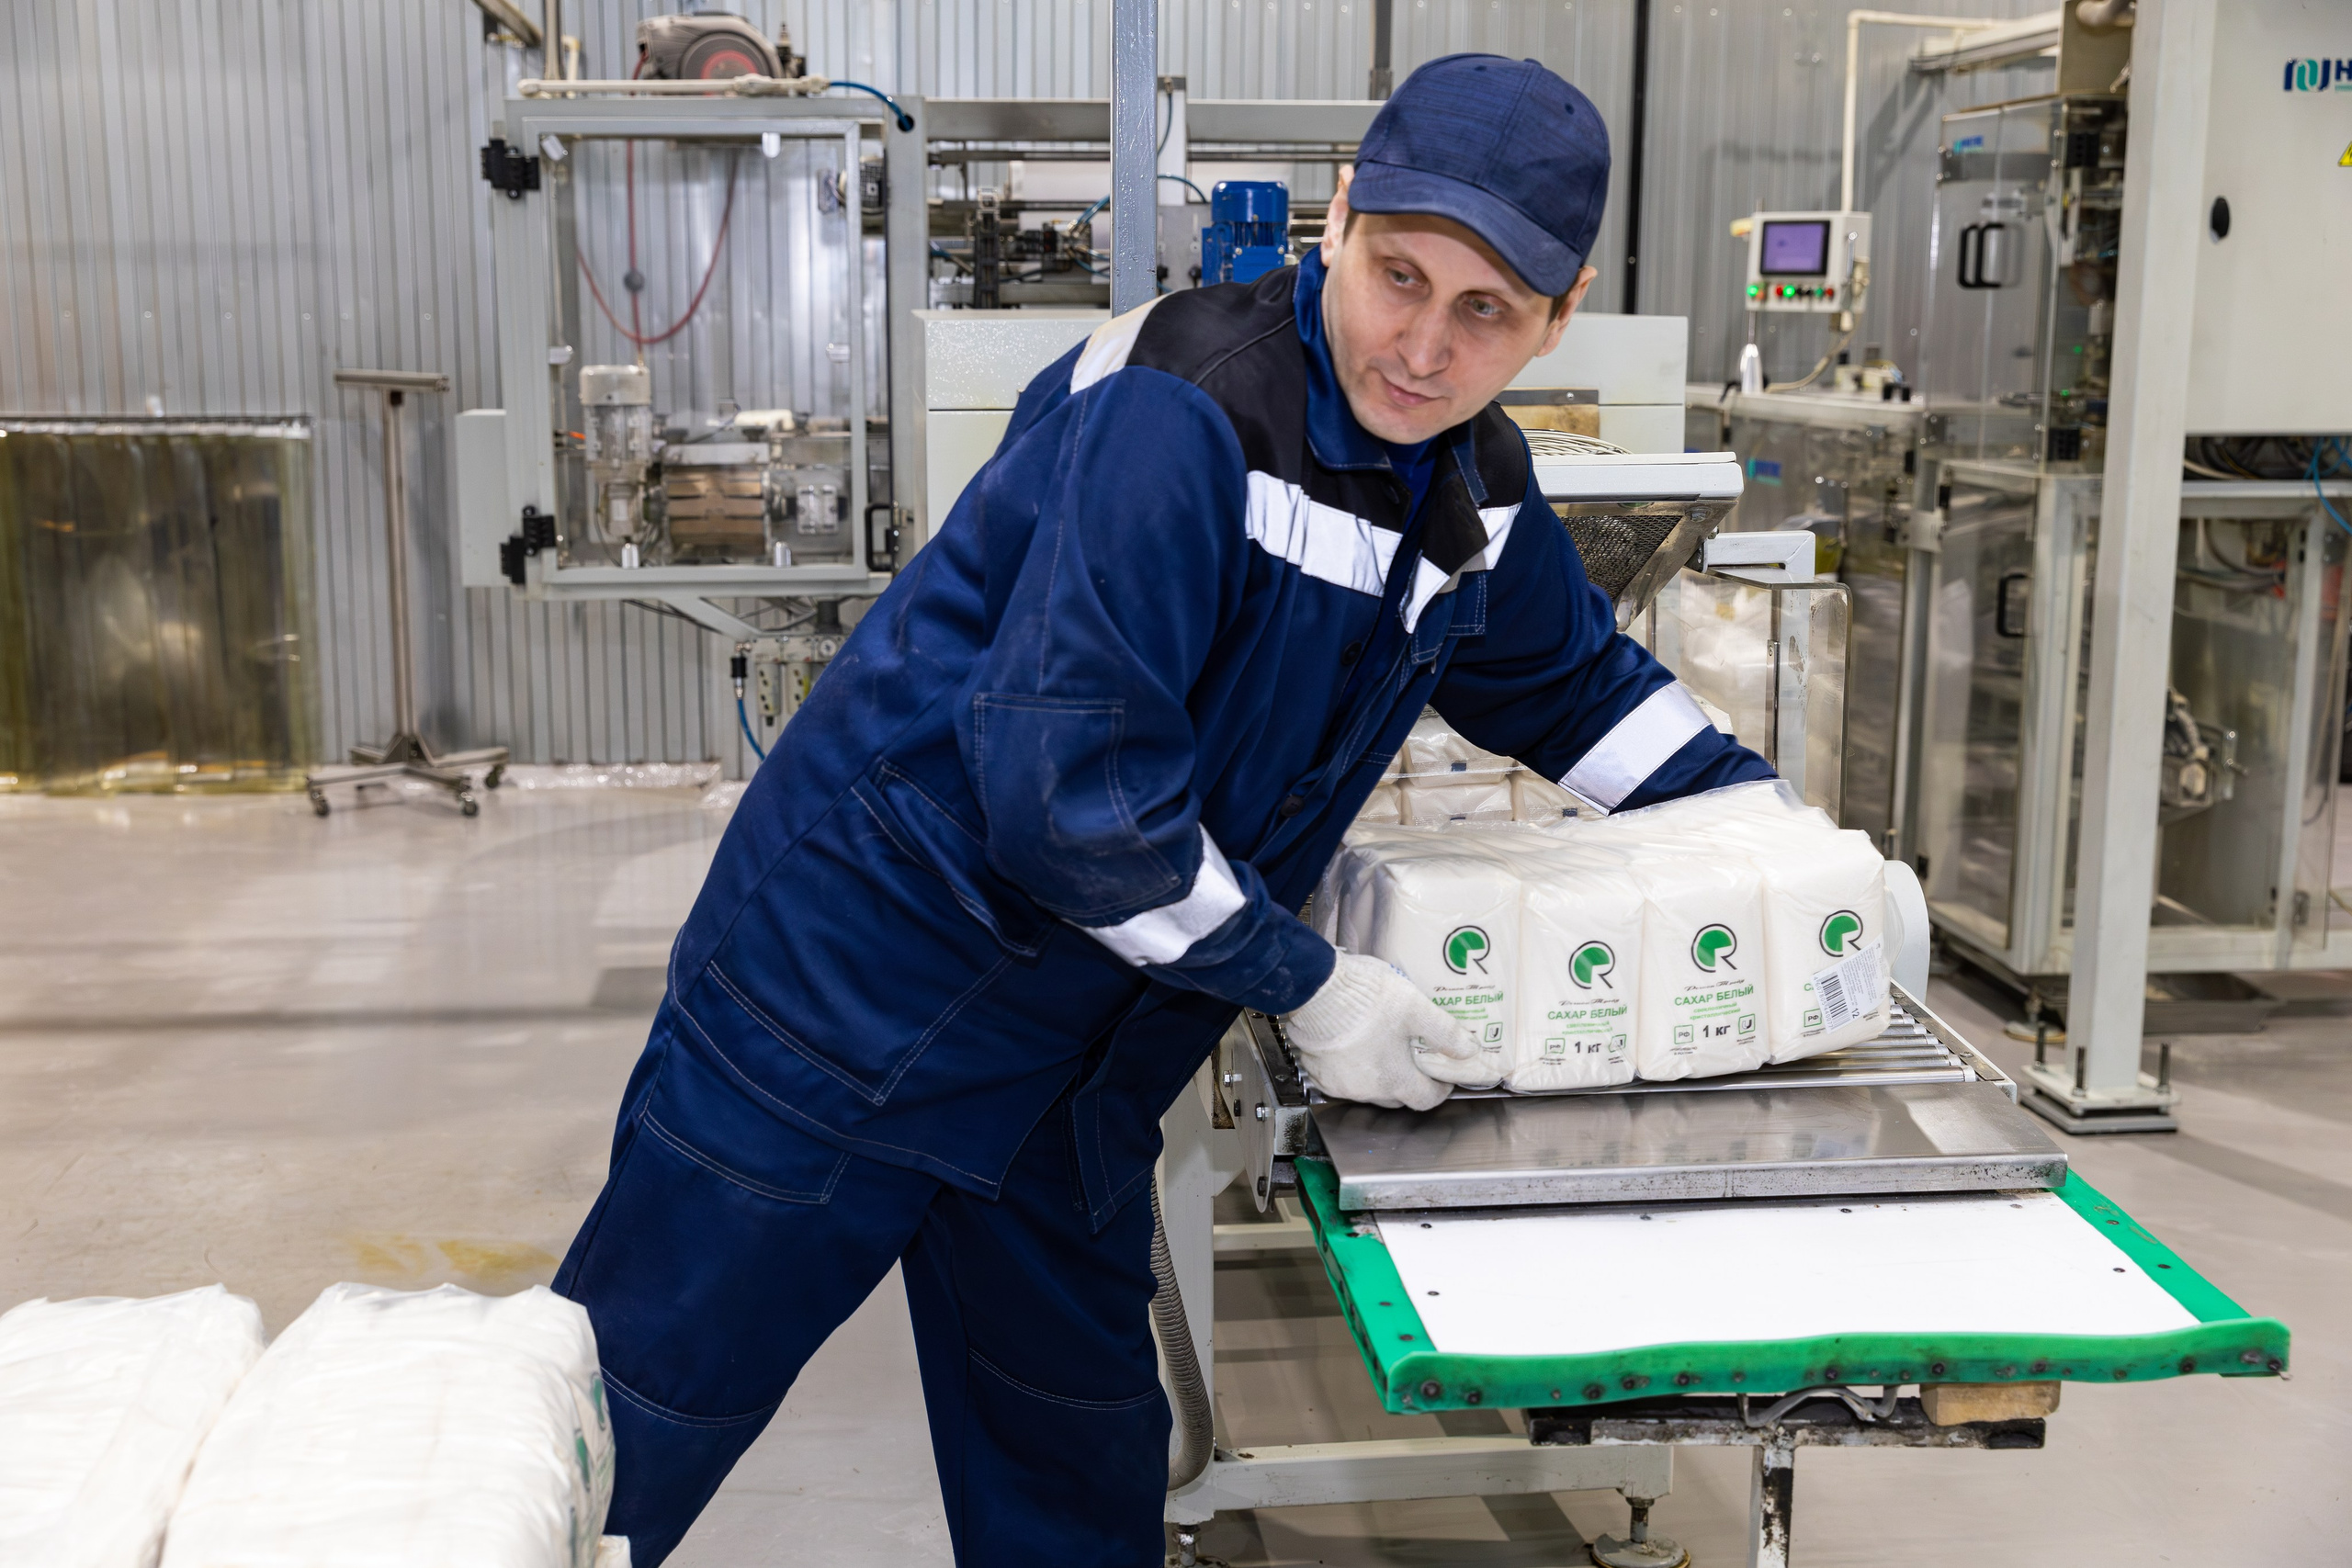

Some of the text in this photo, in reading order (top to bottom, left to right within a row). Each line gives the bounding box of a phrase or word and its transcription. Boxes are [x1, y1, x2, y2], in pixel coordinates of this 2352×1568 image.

[1431, 991, 1504, 1007] АХАР БЕЛЫЙ
[1674, 984, 1754, 1006] САХАР БЕЛЫЙ
[1547, 1004, 1628, 1021] САХАР БЕЛЫЙ
[1702, 1024, 1731, 1038] 1 кг
[1575, 1041, 1602, 1054] 1 кг
